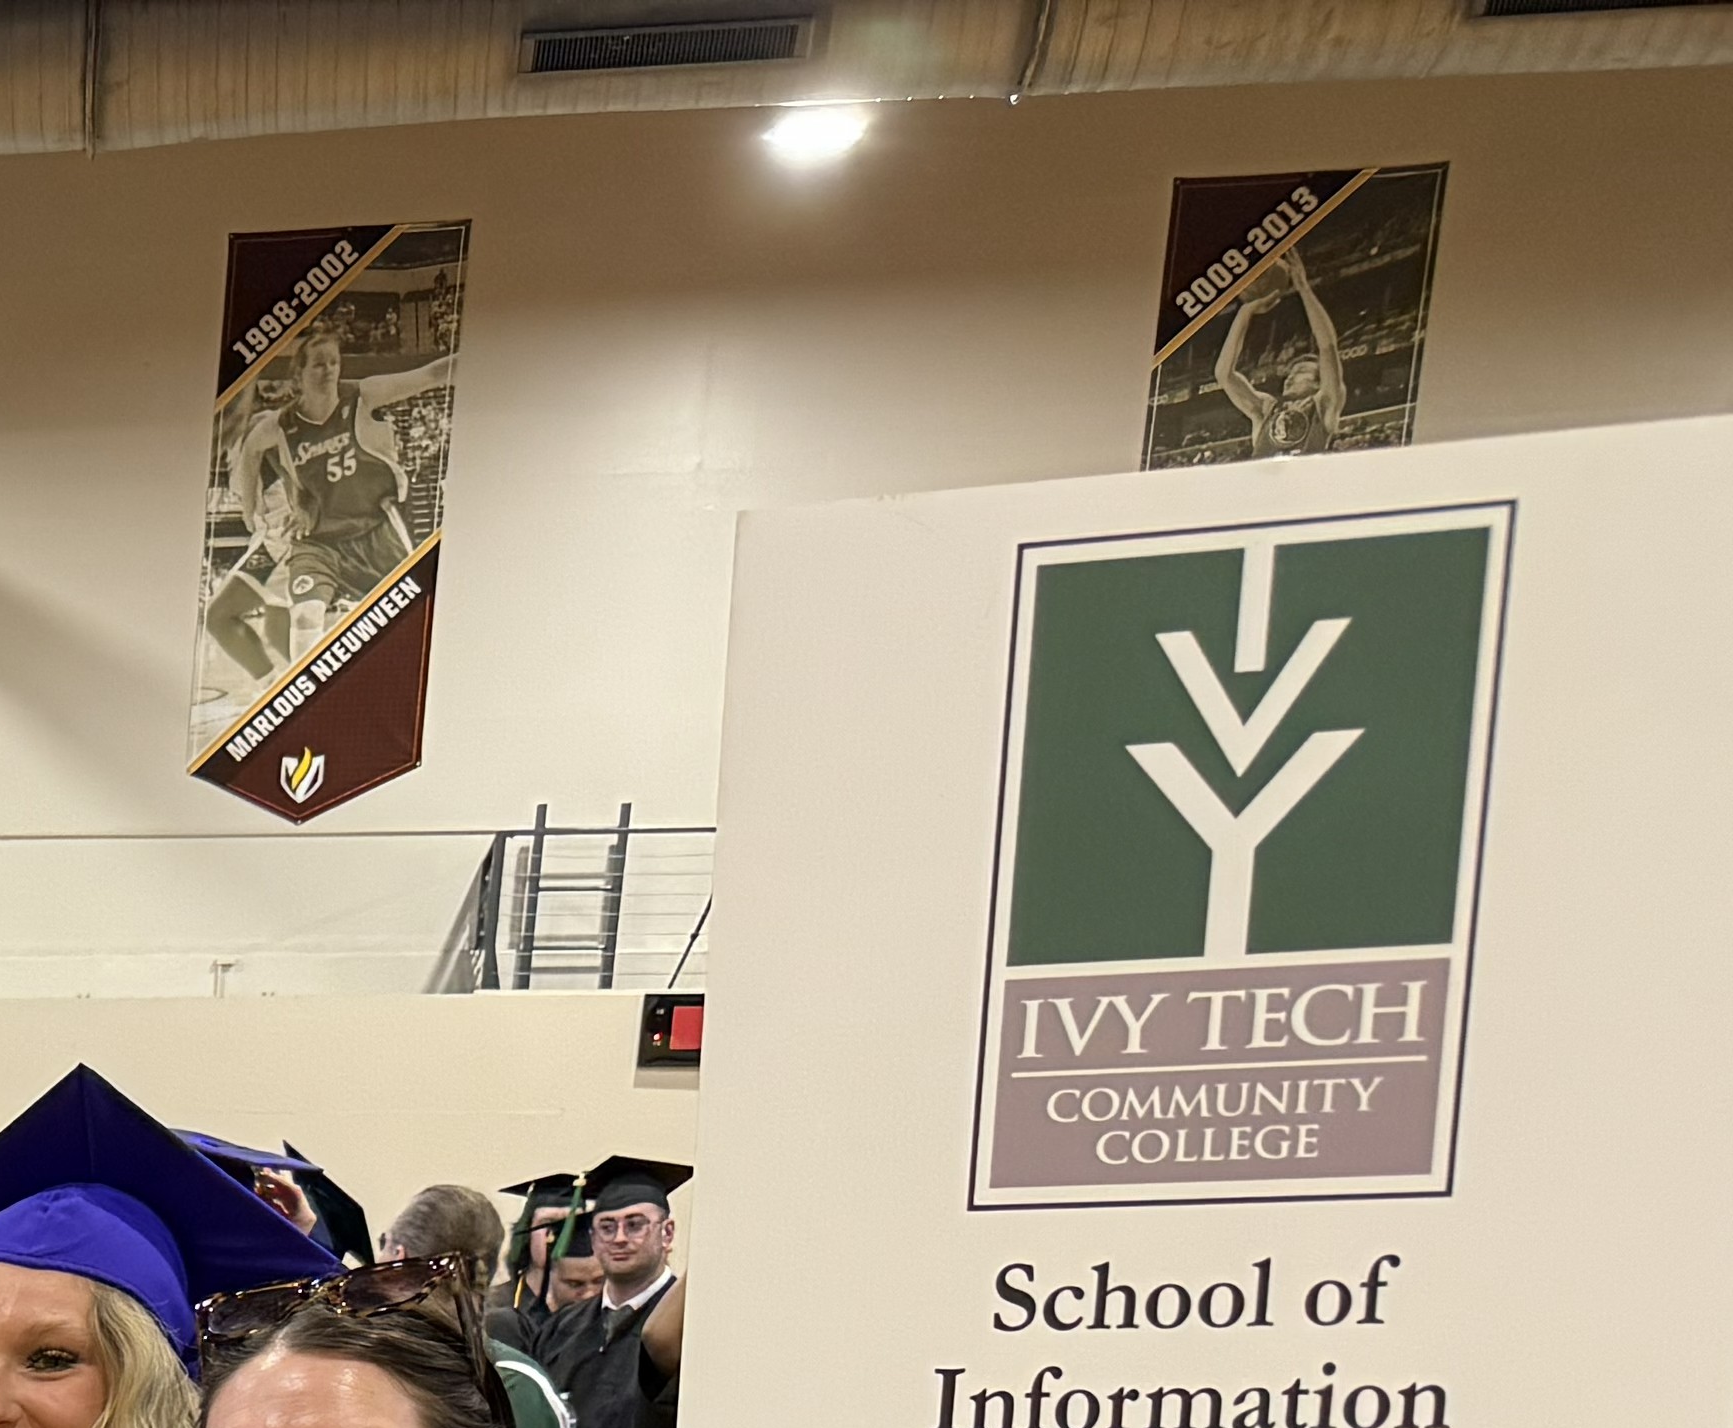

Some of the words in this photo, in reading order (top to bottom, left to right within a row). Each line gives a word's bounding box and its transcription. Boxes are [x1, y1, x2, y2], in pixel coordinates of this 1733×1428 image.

[1176, 186, 1318, 318] 2009-2013
[233, 240, 359, 365] 1998-2002
[327, 447, 357, 482] 55
[226, 675, 317, 761] MARLOUS
[310, 576, 422, 683] NIEUWVEEN
[1016, 992, 1170, 1058] IVY
[1187, 981, 1427, 1051] TECH
[1046, 1077, 1384, 1123] COMMUNITY
[1096, 1124, 1319, 1165] COLLEGE
[993, 1257, 1274, 1332] School
[1304, 1254, 1401, 1326] of
